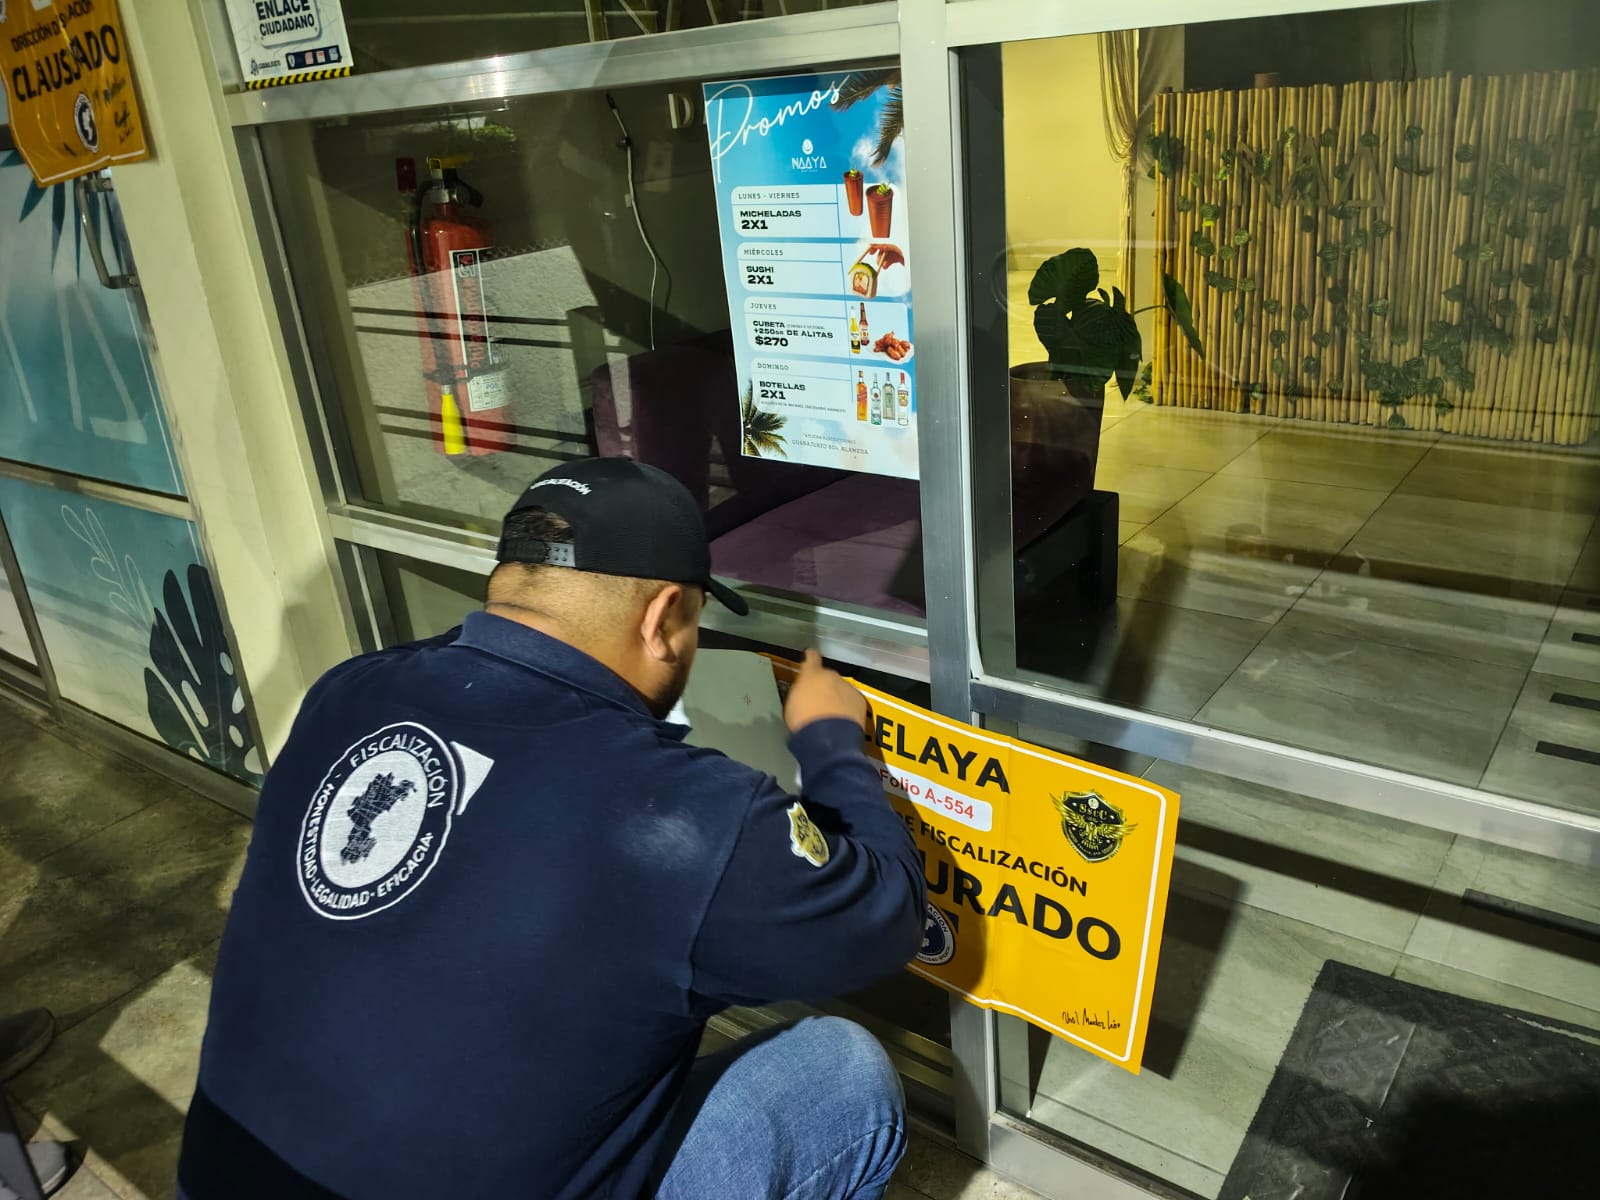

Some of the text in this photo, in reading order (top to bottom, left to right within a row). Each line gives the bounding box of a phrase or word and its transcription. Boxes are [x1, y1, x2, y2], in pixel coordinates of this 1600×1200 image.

[255, 0, 311, 20] ENLACE
[259, 13, 315, 36] CIUDADANO
[704, 74, 850, 183] Promos
[791, 155, 827, 169] NAAYA
[740, 210, 802, 218] MICHELADAS
[741, 219, 768, 230] 2X1
[744, 248, 784, 256] MIÉRCOLES
[746, 265, 774, 273] SUSHI
[747, 274, 774, 285] 2X1
[753, 320, 785, 328] CUBETA
[801, 330, 834, 339] ALITAS
[755, 335, 788, 347] $270
[757, 363, 789, 371] DOMINGO
[759, 381, 806, 391] BOTELLAS
[761, 389, 786, 400] 2X1
[865, 710, 1010, 794] ELAYA
[350, 733, 448, 808] FISCALIZACIÓN
[880, 768, 975, 820] Folio A-554
[920, 820, 1088, 897] FISCALIZACIÓN
[310, 877, 370, 909] LEGALIDAD
[377, 834, 434, 897] EFICACIA
[921, 850, 1121, 961] URADO
